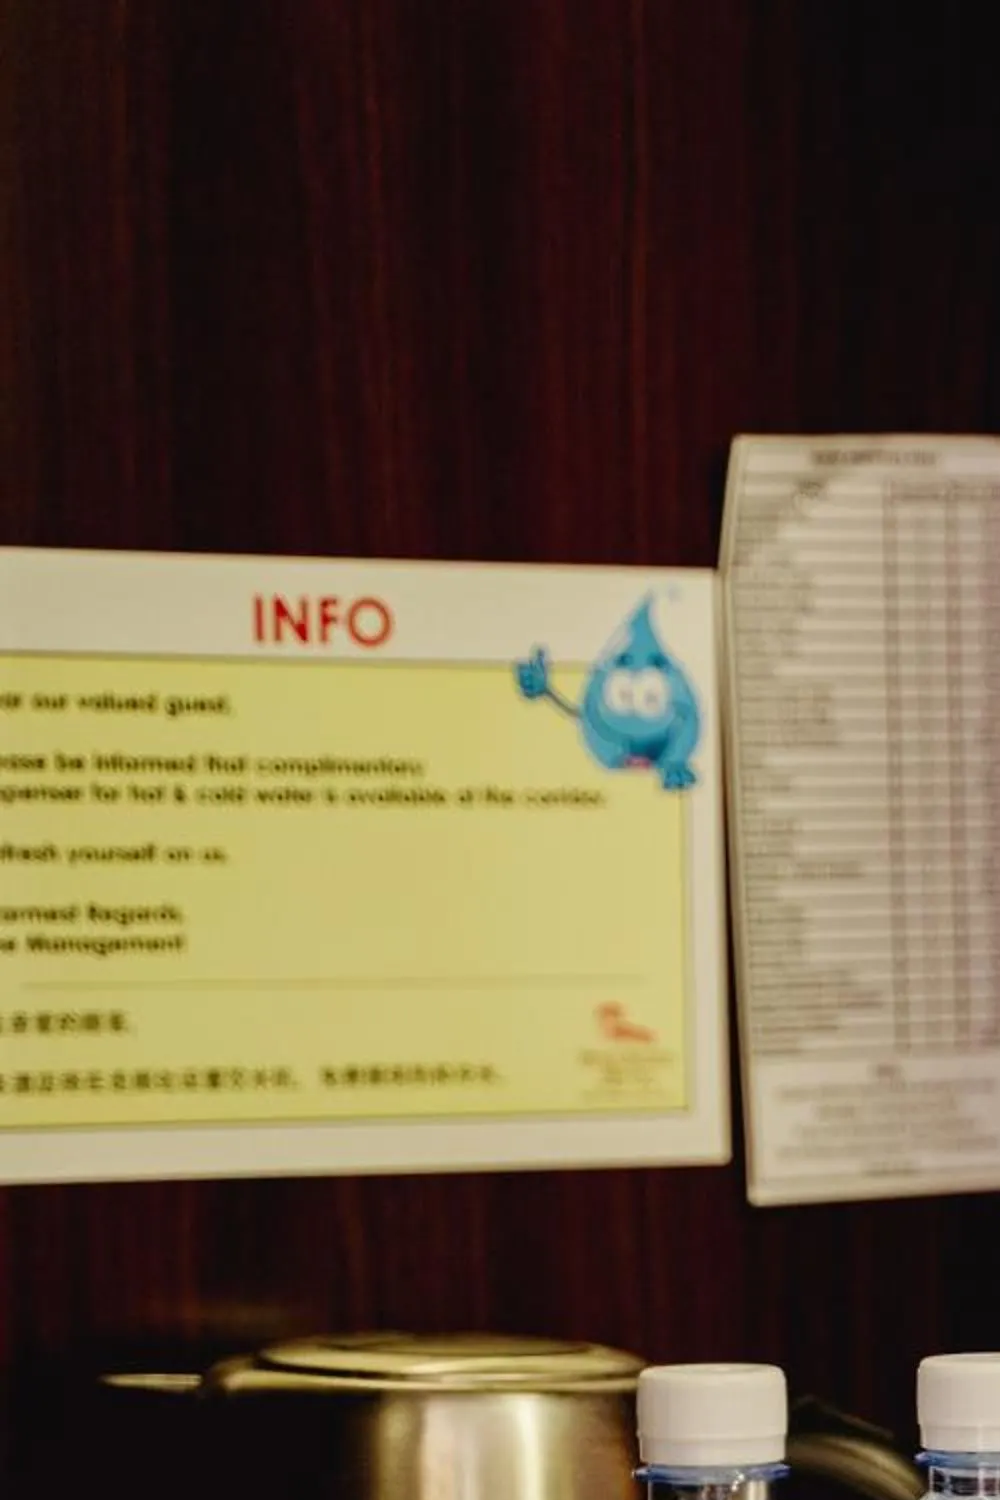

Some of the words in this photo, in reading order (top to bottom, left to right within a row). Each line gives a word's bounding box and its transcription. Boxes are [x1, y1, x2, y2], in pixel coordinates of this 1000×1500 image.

[253, 595, 392, 646] INFO
[34, 693, 66, 711] our
[77, 691, 156, 713] valued
[54, 751, 84, 771] be
[93, 751, 196, 772] informed
[204, 753, 247, 773] that
[256, 754, 426, 780] complimentary
[90, 783, 119, 803] for
[127, 783, 164, 804] hot
[173, 785, 187, 803] &
[197, 783, 245, 806] cold
[256, 785, 312, 806] water
[324, 785, 339, 805] is
[350, 784, 447, 808] available
[457, 786, 475, 806] at
[483, 784, 515, 806] the
[67, 842, 156, 868] yourself
[167, 847, 191, 863] on
[26, 936, 186, 957] Management
